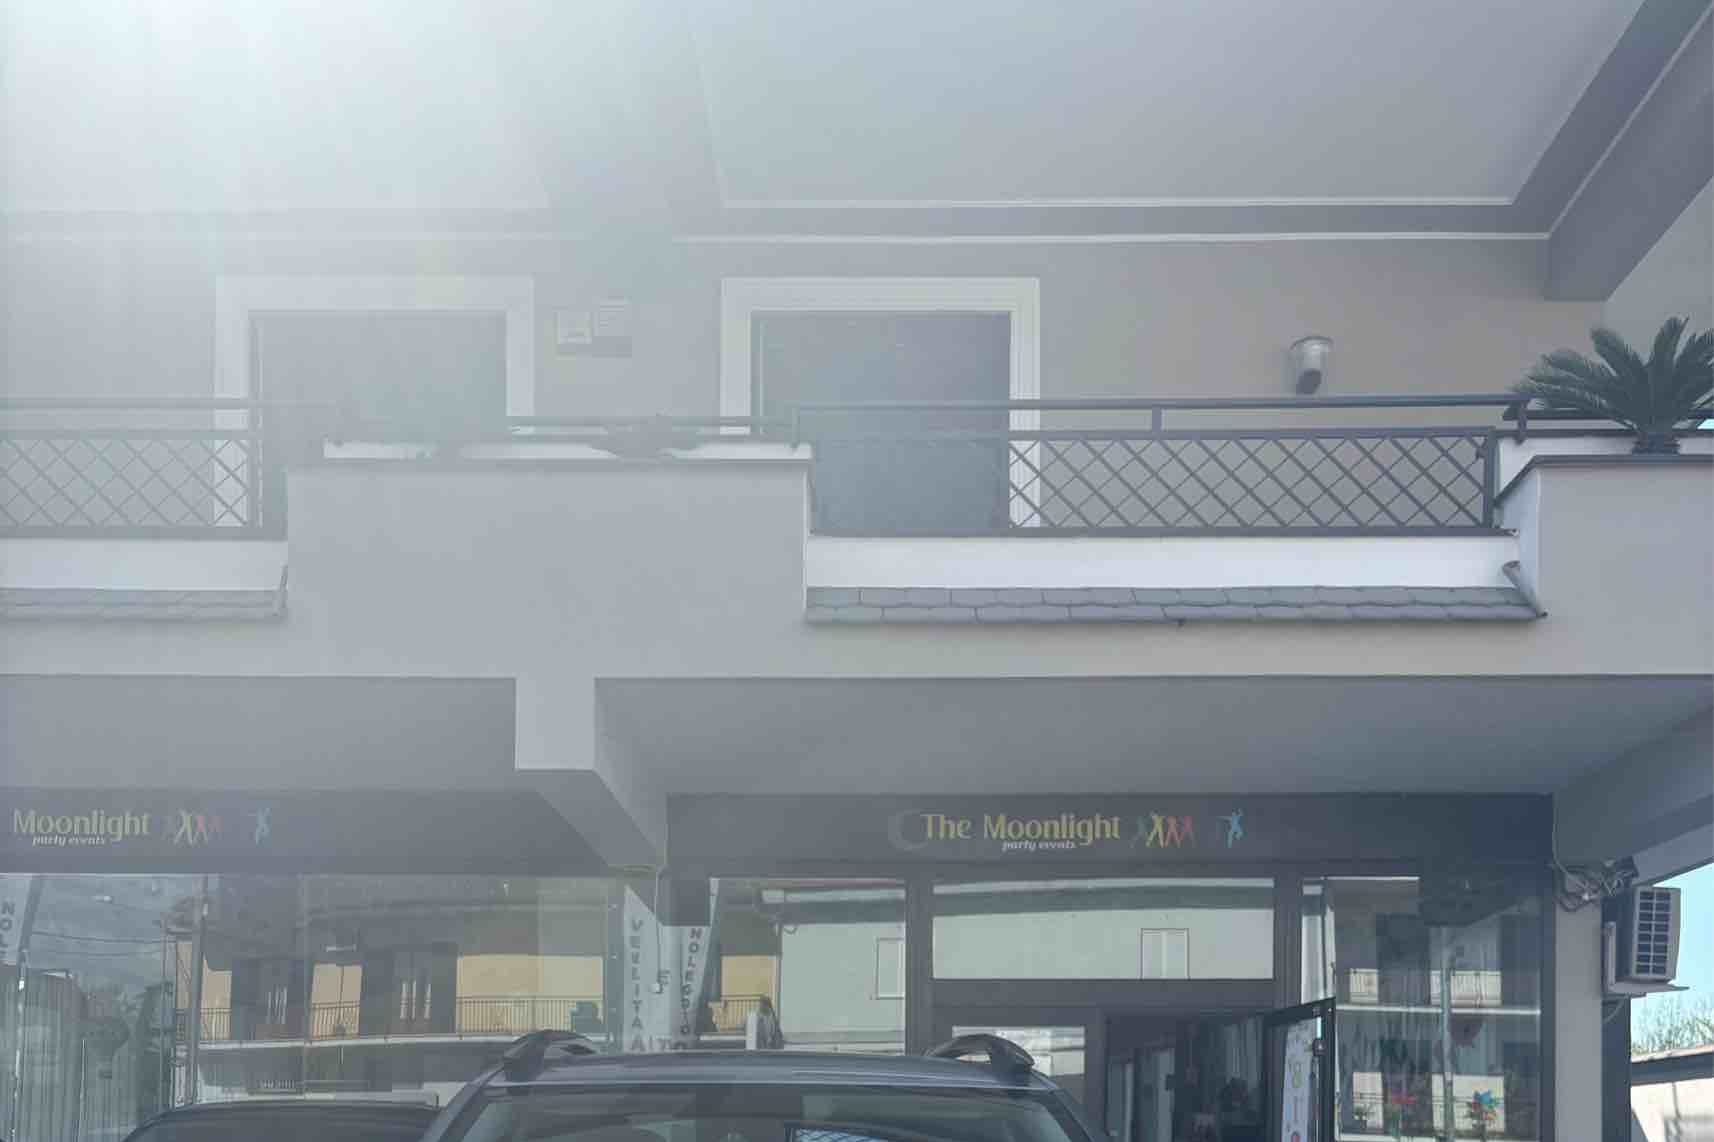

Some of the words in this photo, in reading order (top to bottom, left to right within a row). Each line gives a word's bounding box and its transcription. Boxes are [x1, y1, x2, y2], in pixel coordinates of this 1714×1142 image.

[13, 808, 150, 841] Moonlight
[921, 813, 972, 840] The
[983, 813, 1121, 845] Moonlight
[32, 834, 65, 847] party
[67, 834, 106, 846] events
[1001, 840, 1037, 853] party
[1038, 840, 1077, 850] events
